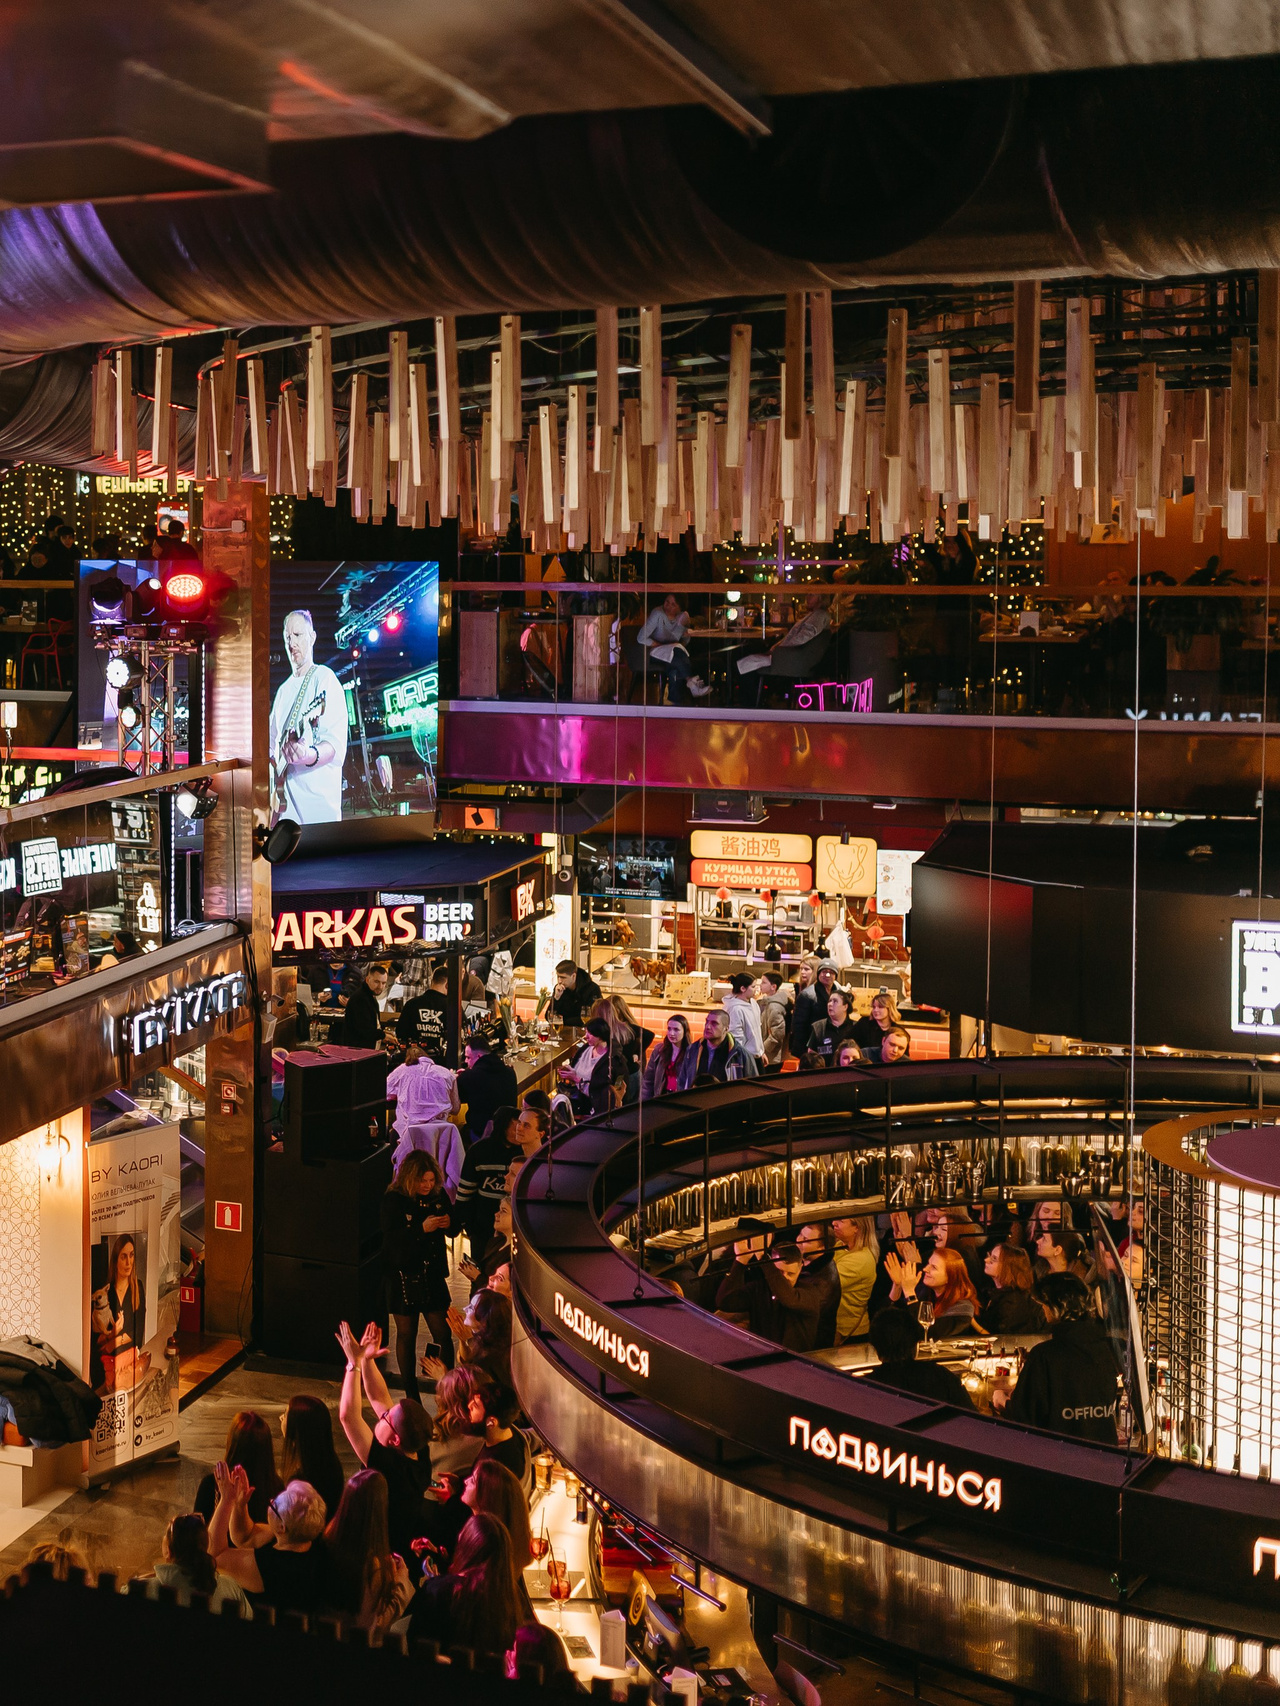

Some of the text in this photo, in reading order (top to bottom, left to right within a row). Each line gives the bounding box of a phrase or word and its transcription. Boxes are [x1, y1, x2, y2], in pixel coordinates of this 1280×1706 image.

[721, 836, 781, 858] 酱油鸡
[702, 873, 800, 887] ПО-ГОНКОНГСКИ
[704, 863, 797, 877] КУРИЦА И УТКА
[423, 902, 474, 922] BEER
[91, 1153, 163, 1184] BY KAORI
[554, 1287, 650, 1378] ПОДВИНЬСЯ
[1061, 1406, 1117, 1421] OFFICIA
[789, 1416, 1003, 1513] ПОДВИНЬСЯ
